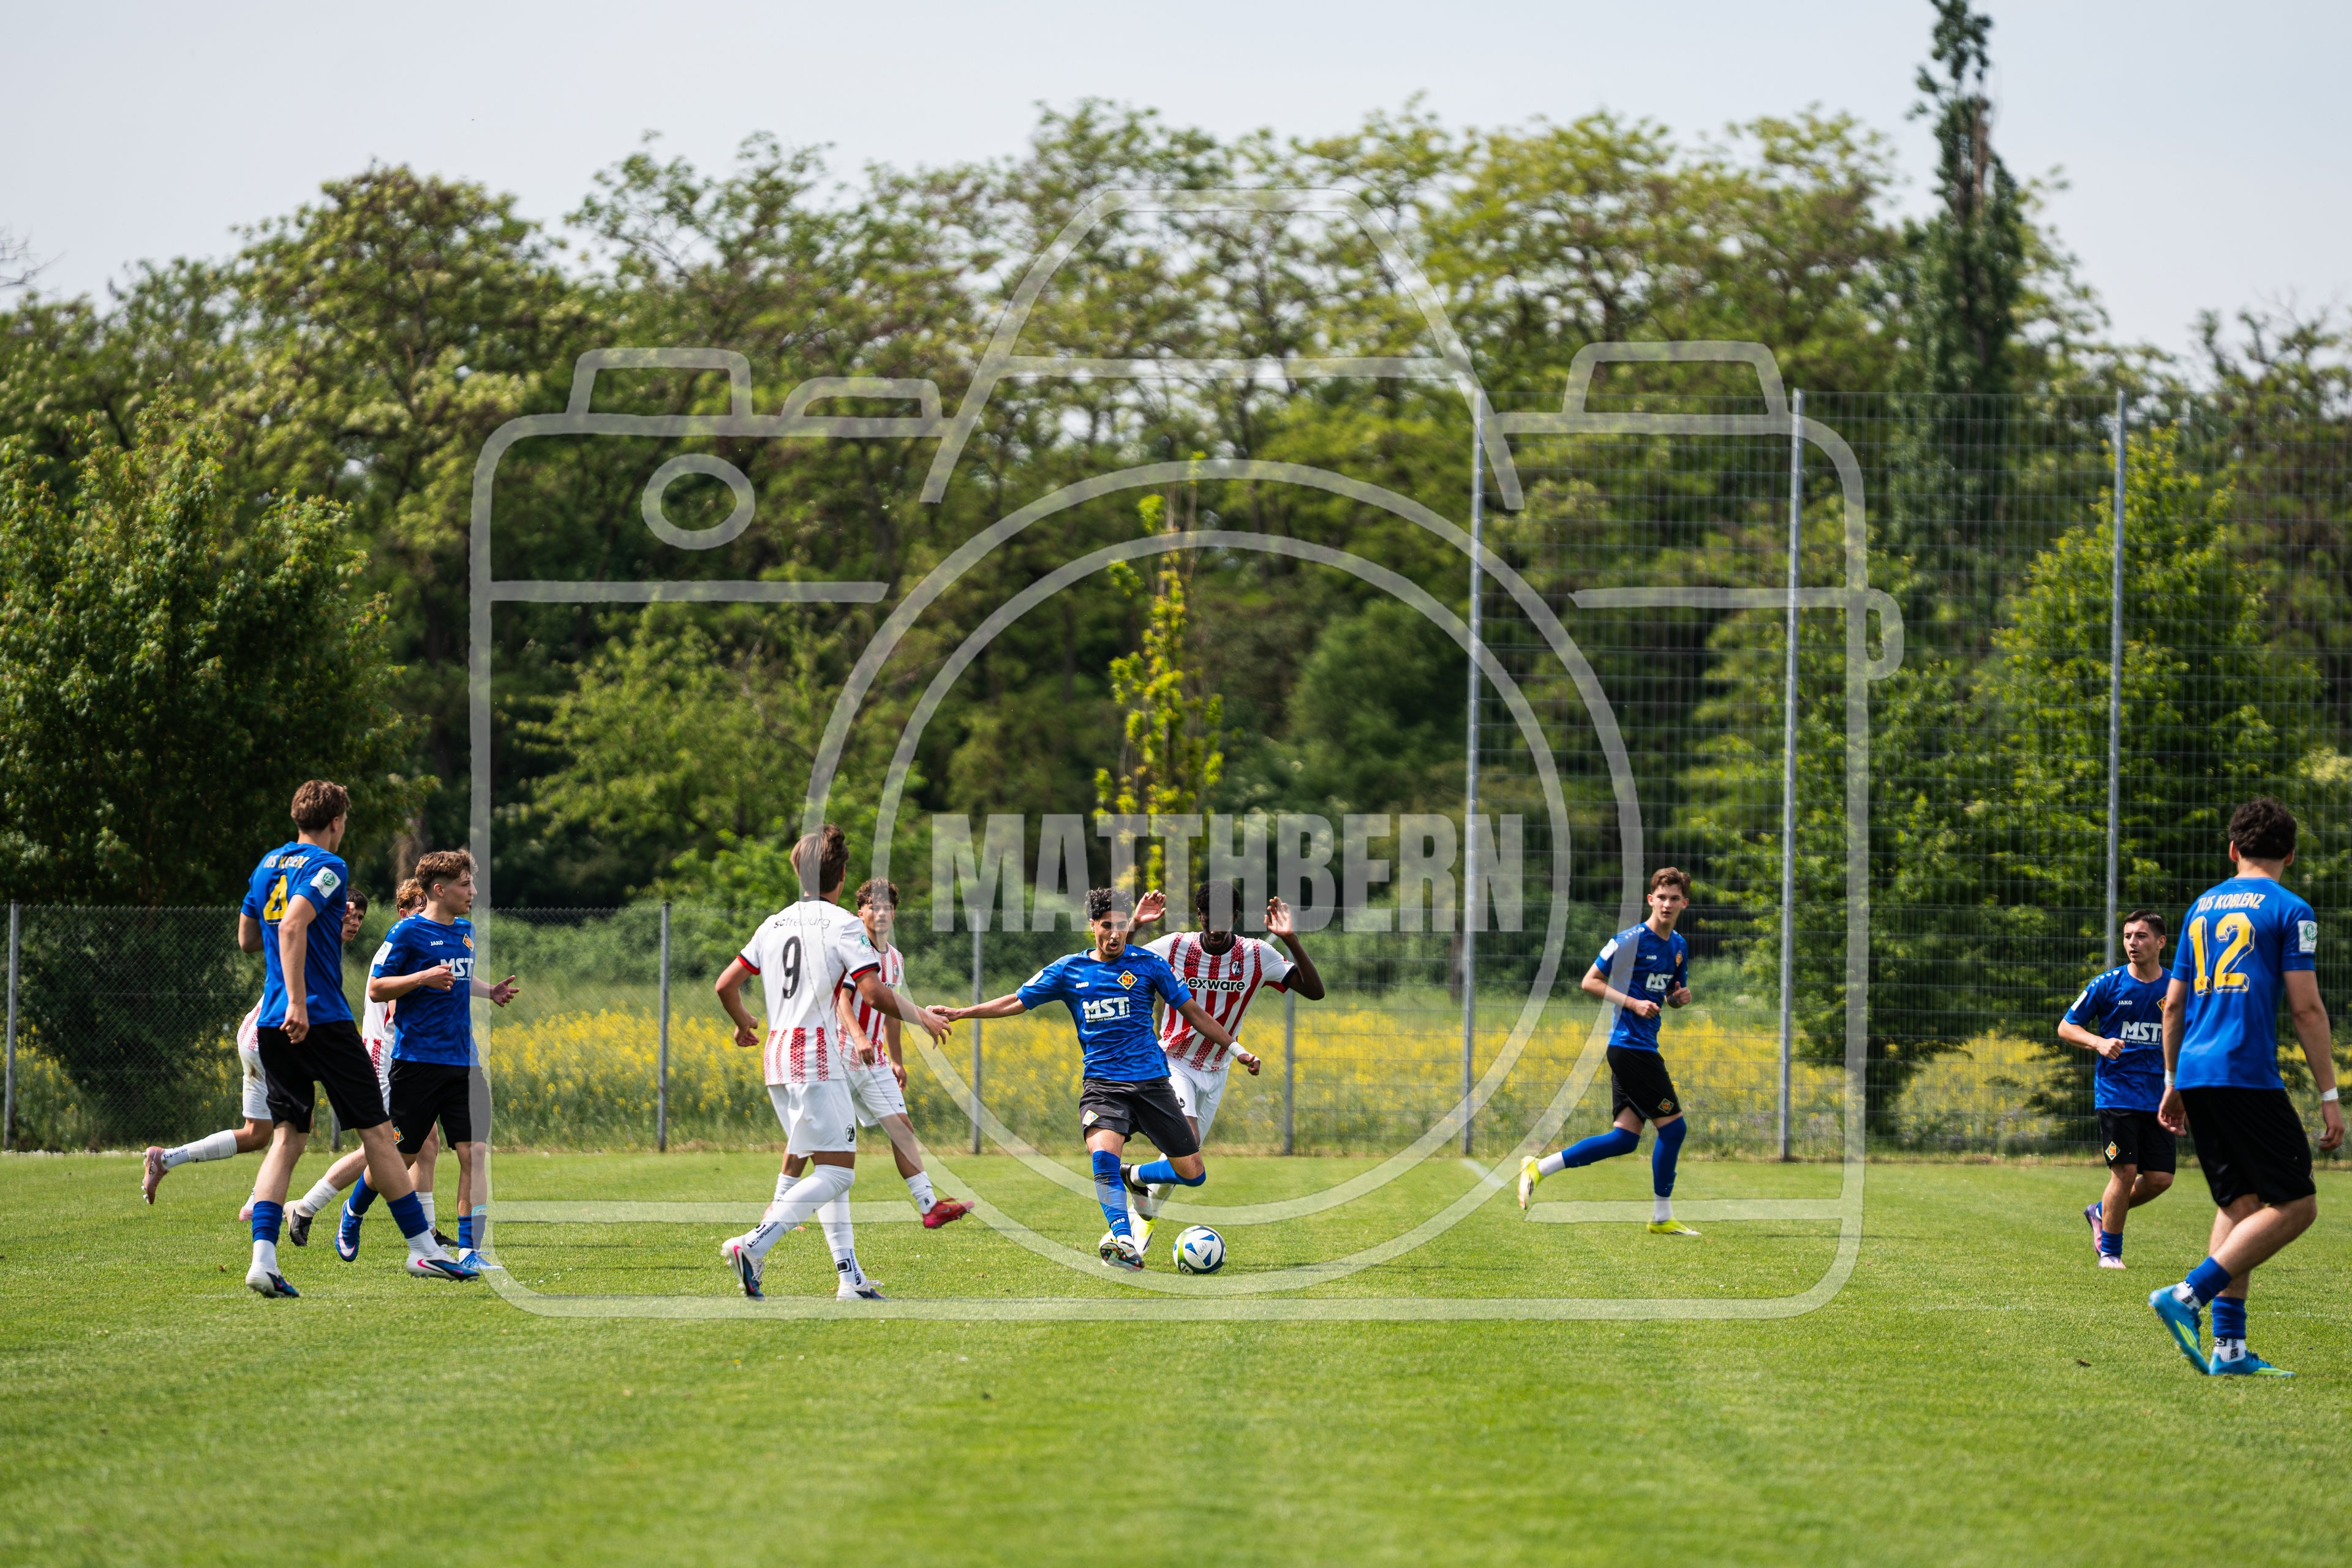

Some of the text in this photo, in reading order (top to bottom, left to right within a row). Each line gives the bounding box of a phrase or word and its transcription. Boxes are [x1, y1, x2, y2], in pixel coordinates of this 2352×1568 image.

[263, 875, 288, 925] 4
[2196, 892, 2266, 912] TUS KOBLENZ
[2188, 912, 2256, 997] 12
[440, 958, 474, 977] MST
[782, 936, 802, 1000] 9
[1082, 997, 1129, 1020] MST
[2120, 1021, 2162, 1042] MST
